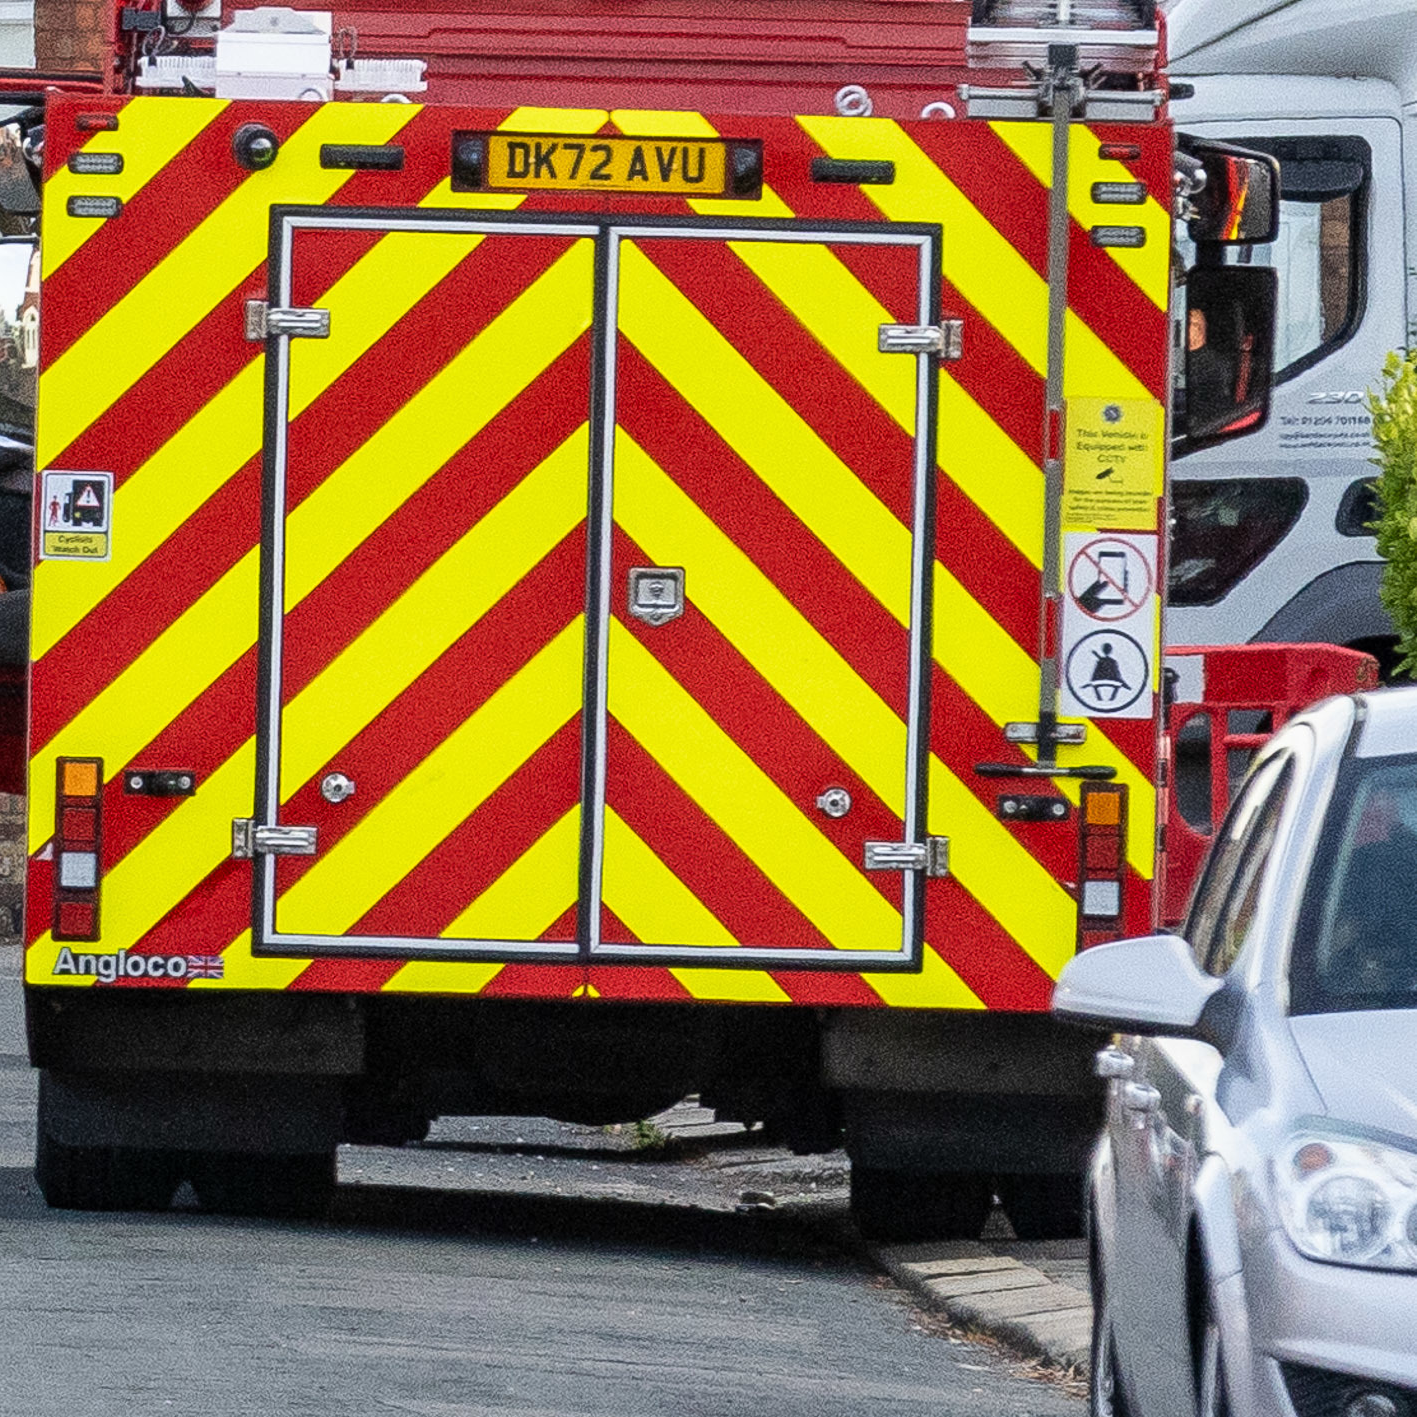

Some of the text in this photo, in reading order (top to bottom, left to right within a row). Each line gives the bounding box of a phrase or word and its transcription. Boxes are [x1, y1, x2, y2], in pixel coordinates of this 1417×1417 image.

[505, 141, 706, 184] DK72 AVU
[1308, 391, 1364, 405] 230
[1097, 454, 1126, 463] CCTV
[52, 946, 187, 983] Angloco
